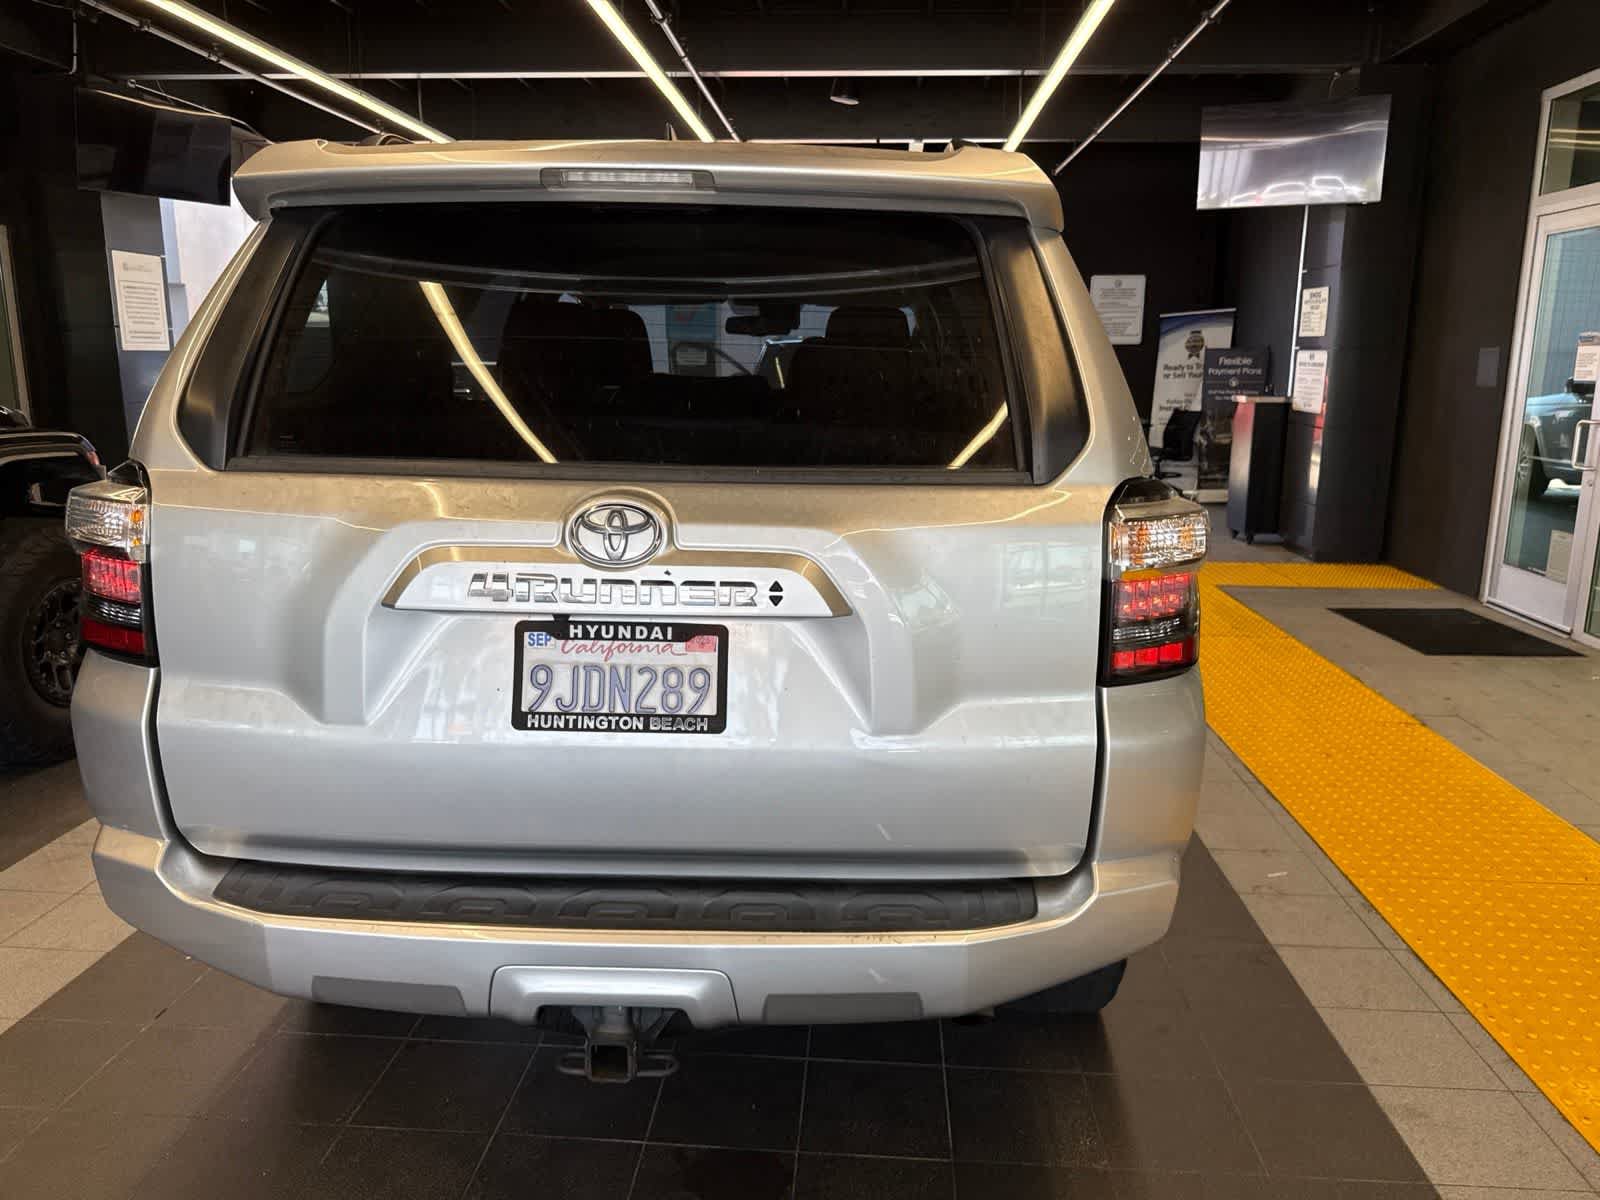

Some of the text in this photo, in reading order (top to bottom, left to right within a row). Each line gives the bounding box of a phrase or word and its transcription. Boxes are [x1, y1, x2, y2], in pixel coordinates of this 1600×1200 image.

[1162, 363, 1184, 372] Ready
[1218, 355, 1253, 366] Flexible
[1207, 367, 1262, 377] Payment Plans
[527, 632, 552, 647] SEP
[568, 625, 674, 641] HYUNDAI
[560, 639, 687, 663] California
[527, 663, 712, 716] 9JDN289
[527, 714, 709, 732] HUNTINGTON BEACH
